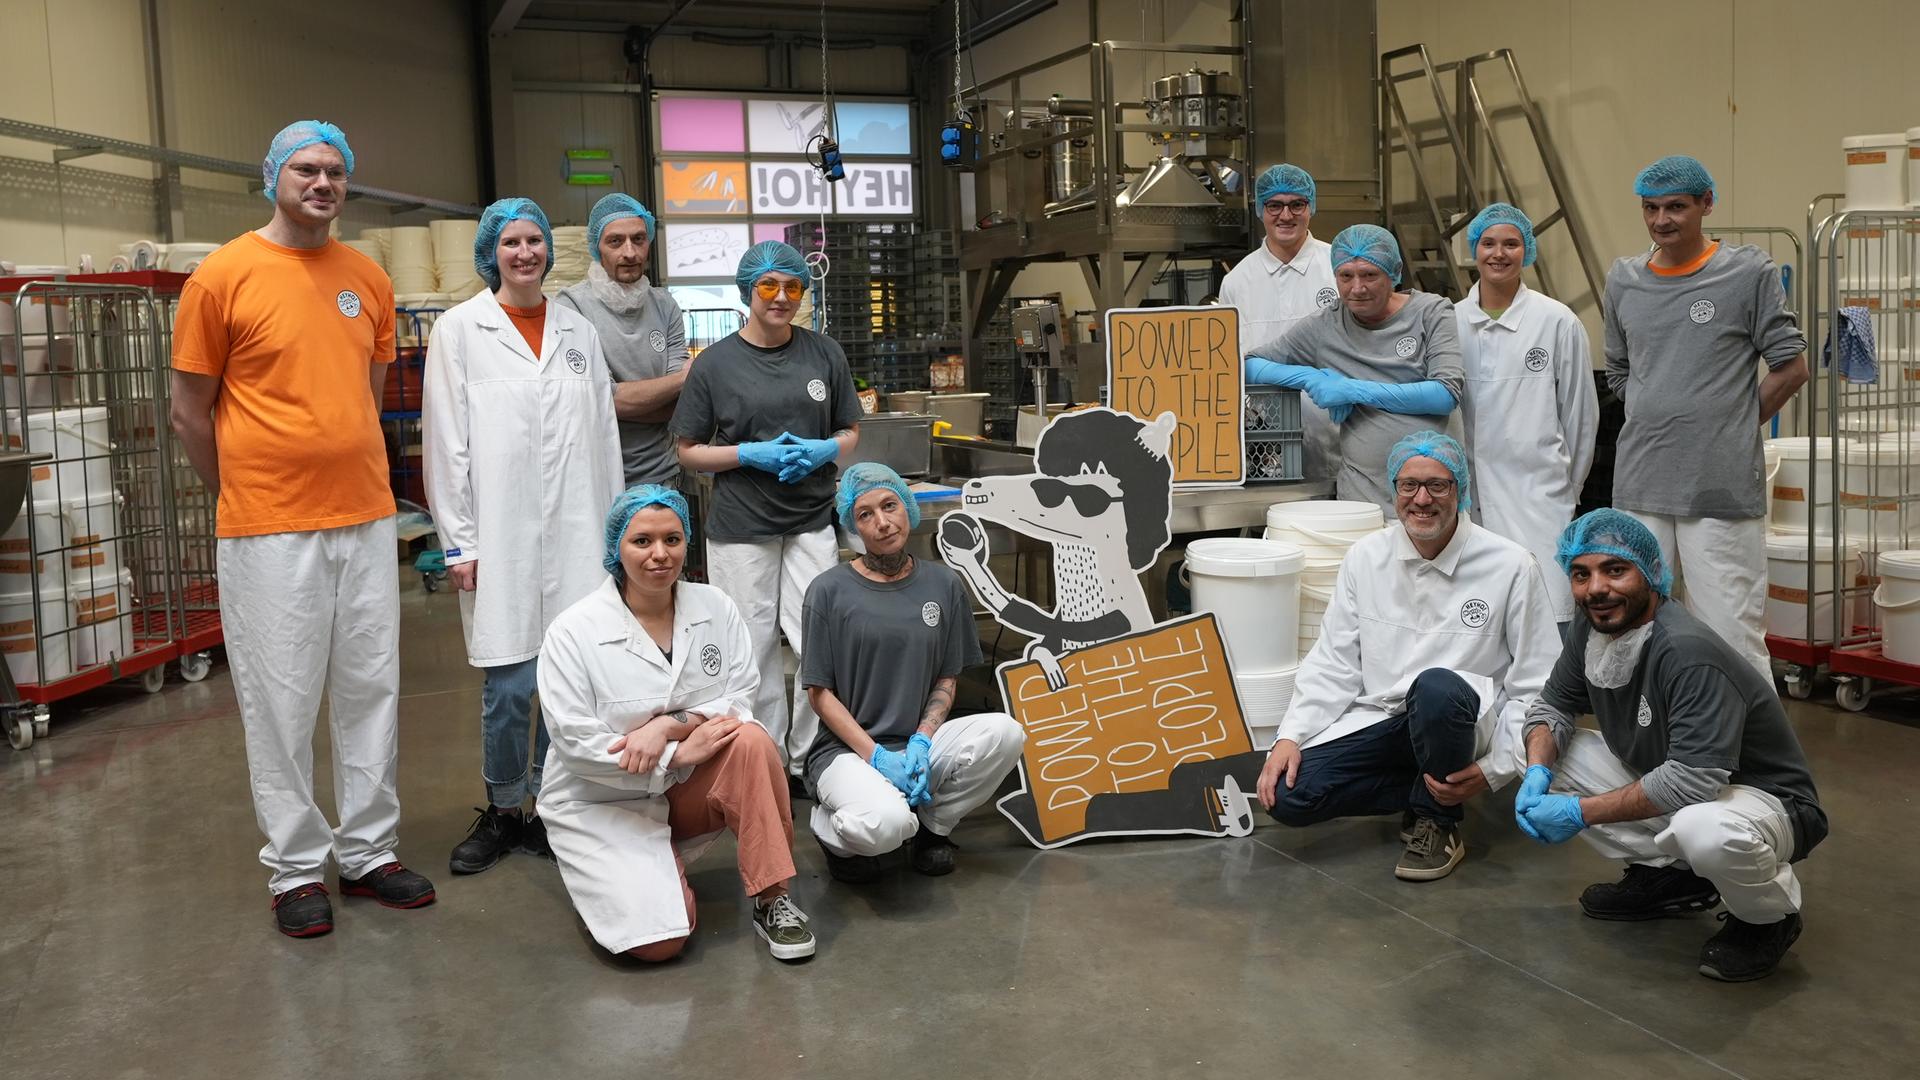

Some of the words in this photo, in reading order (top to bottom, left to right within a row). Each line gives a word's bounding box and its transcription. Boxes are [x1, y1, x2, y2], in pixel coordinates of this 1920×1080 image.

[1118, 317, 1230, 373] POWER
[1117, 376, 1157, 419] TO
[1171, 372, 1232, 418] THE
[1176, 421, 1233, 475] PLE
[1082, 646, 1148, 732] THE
[1018, 662, 1100, 811] POWER
[1106, 741, 1165, 795] TO
